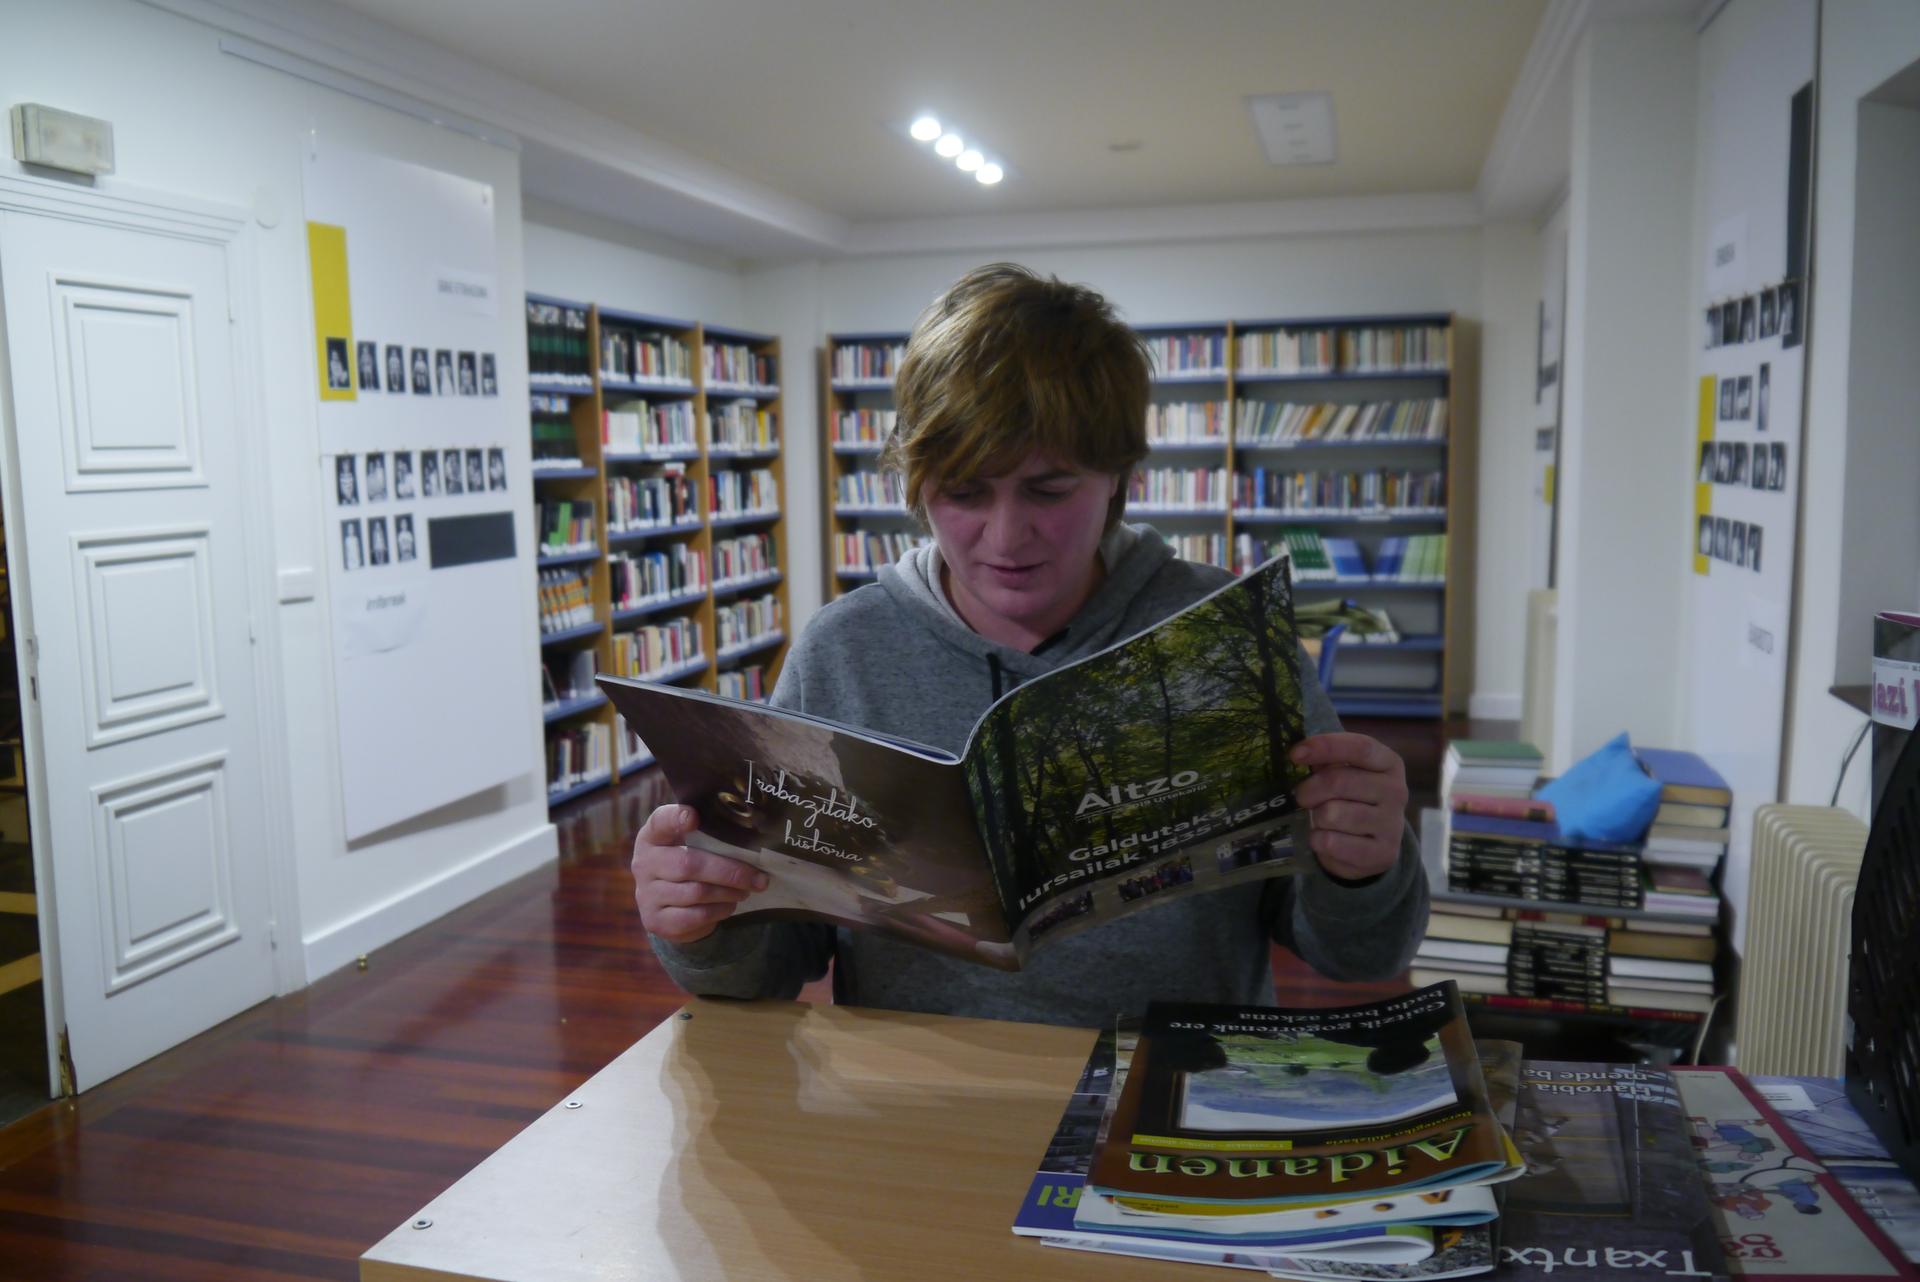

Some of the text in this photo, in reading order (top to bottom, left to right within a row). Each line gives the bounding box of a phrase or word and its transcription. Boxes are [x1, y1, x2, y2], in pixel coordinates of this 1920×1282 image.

[1075, 771, 1199, 815] Altzo
[784, 820, 863, 862] historia
[1068, 807, 1228, 862] Galdutako
[1149, 794, 1287, 855] 1835-1836
[1239, 990, 1444, 1022] badu bere azkena
[1169, 1021, 1206, 1030] ere
[1212, 1021, 1353, 1034] gogorrenak
[1535, 1083, 1651, 1097] Harrobia
[1560, 1070, 1649, 1082] mende
[1127, 1123, 1475, 1184] Aidanen
